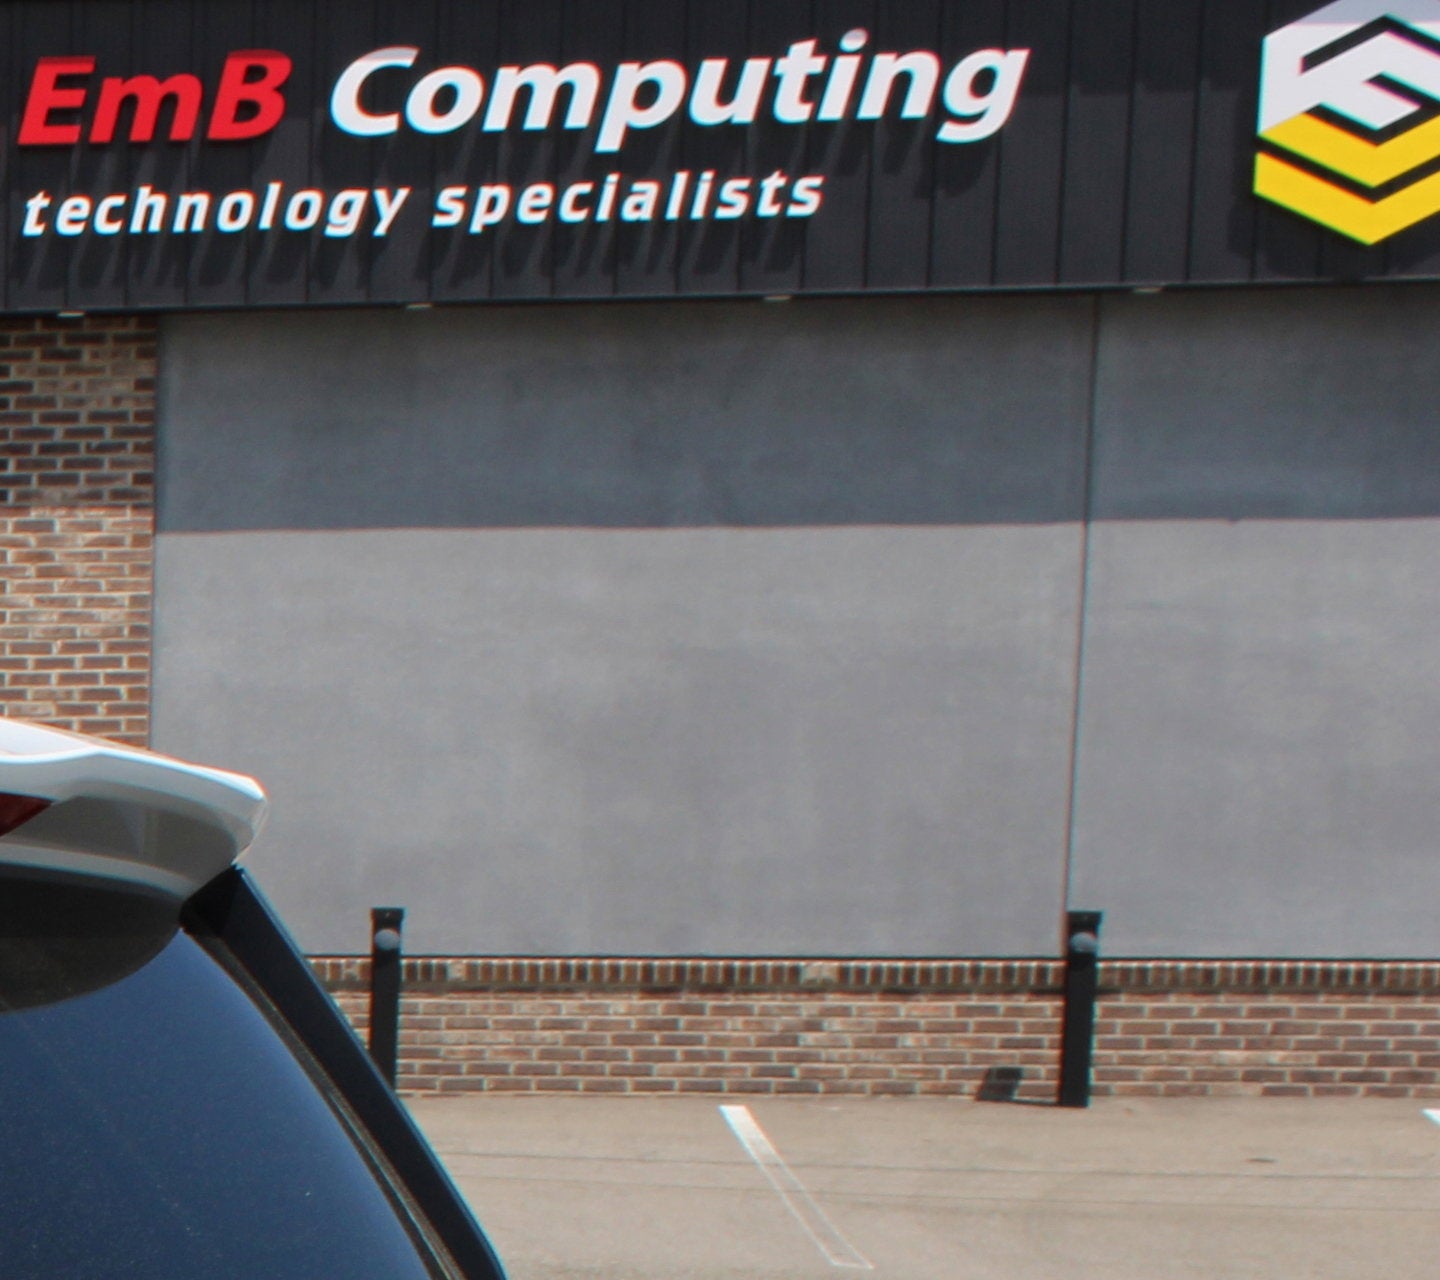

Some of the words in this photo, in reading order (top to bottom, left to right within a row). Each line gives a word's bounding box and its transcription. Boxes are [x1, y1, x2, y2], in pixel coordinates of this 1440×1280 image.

[18, 48, 292, 146] EmB
[329, 29, 1031, 152] Computing
[23, 180, 411, 238] technology
[432, 169, 825, 234] specialists
